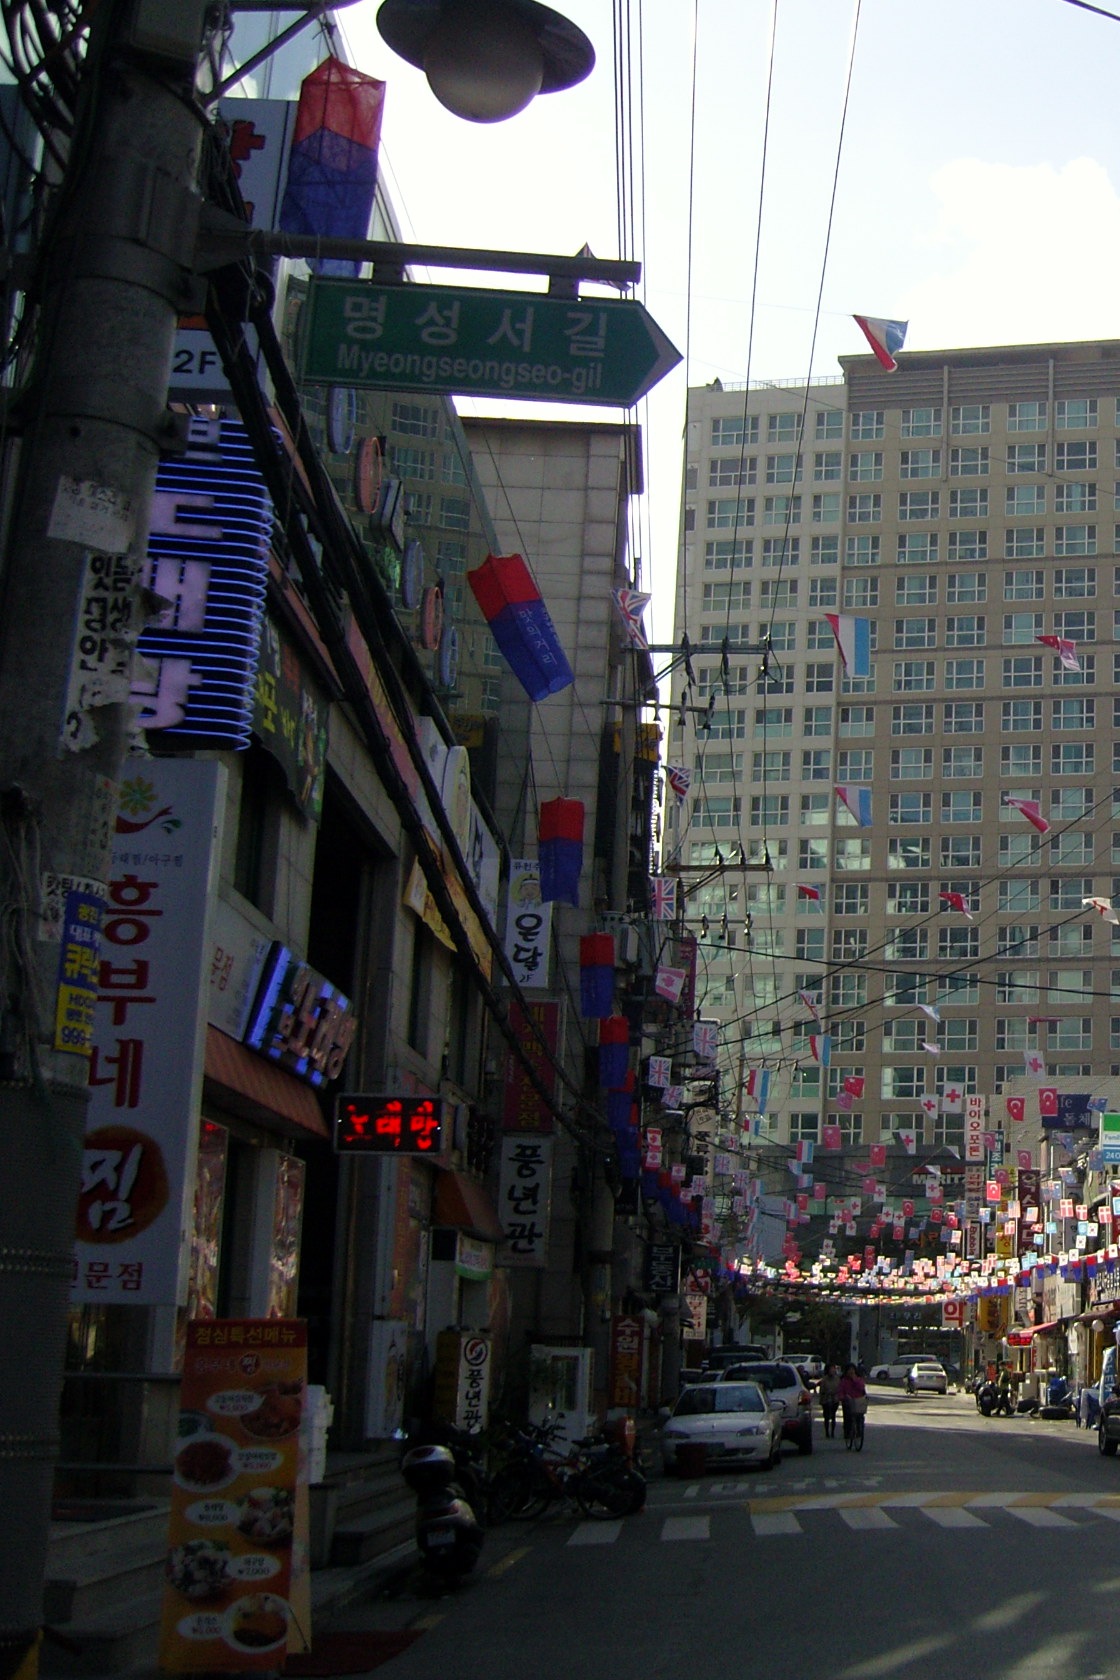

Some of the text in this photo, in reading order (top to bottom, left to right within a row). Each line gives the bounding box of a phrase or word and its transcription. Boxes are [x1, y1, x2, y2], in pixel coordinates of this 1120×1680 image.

[342, 294, 608, 358] 명성서길
[173, 350, 217, 375] 2F
[337, 343, 601, 394] Myeongseongseo-gil
[89, 873, 163, 1109] 흥부네
[505, 1143, 546, 1254] 풍년관
[195, 1325, 297, 1345] 점심특선메뉴
[463, 1368, 484, 1429] 풍년관
